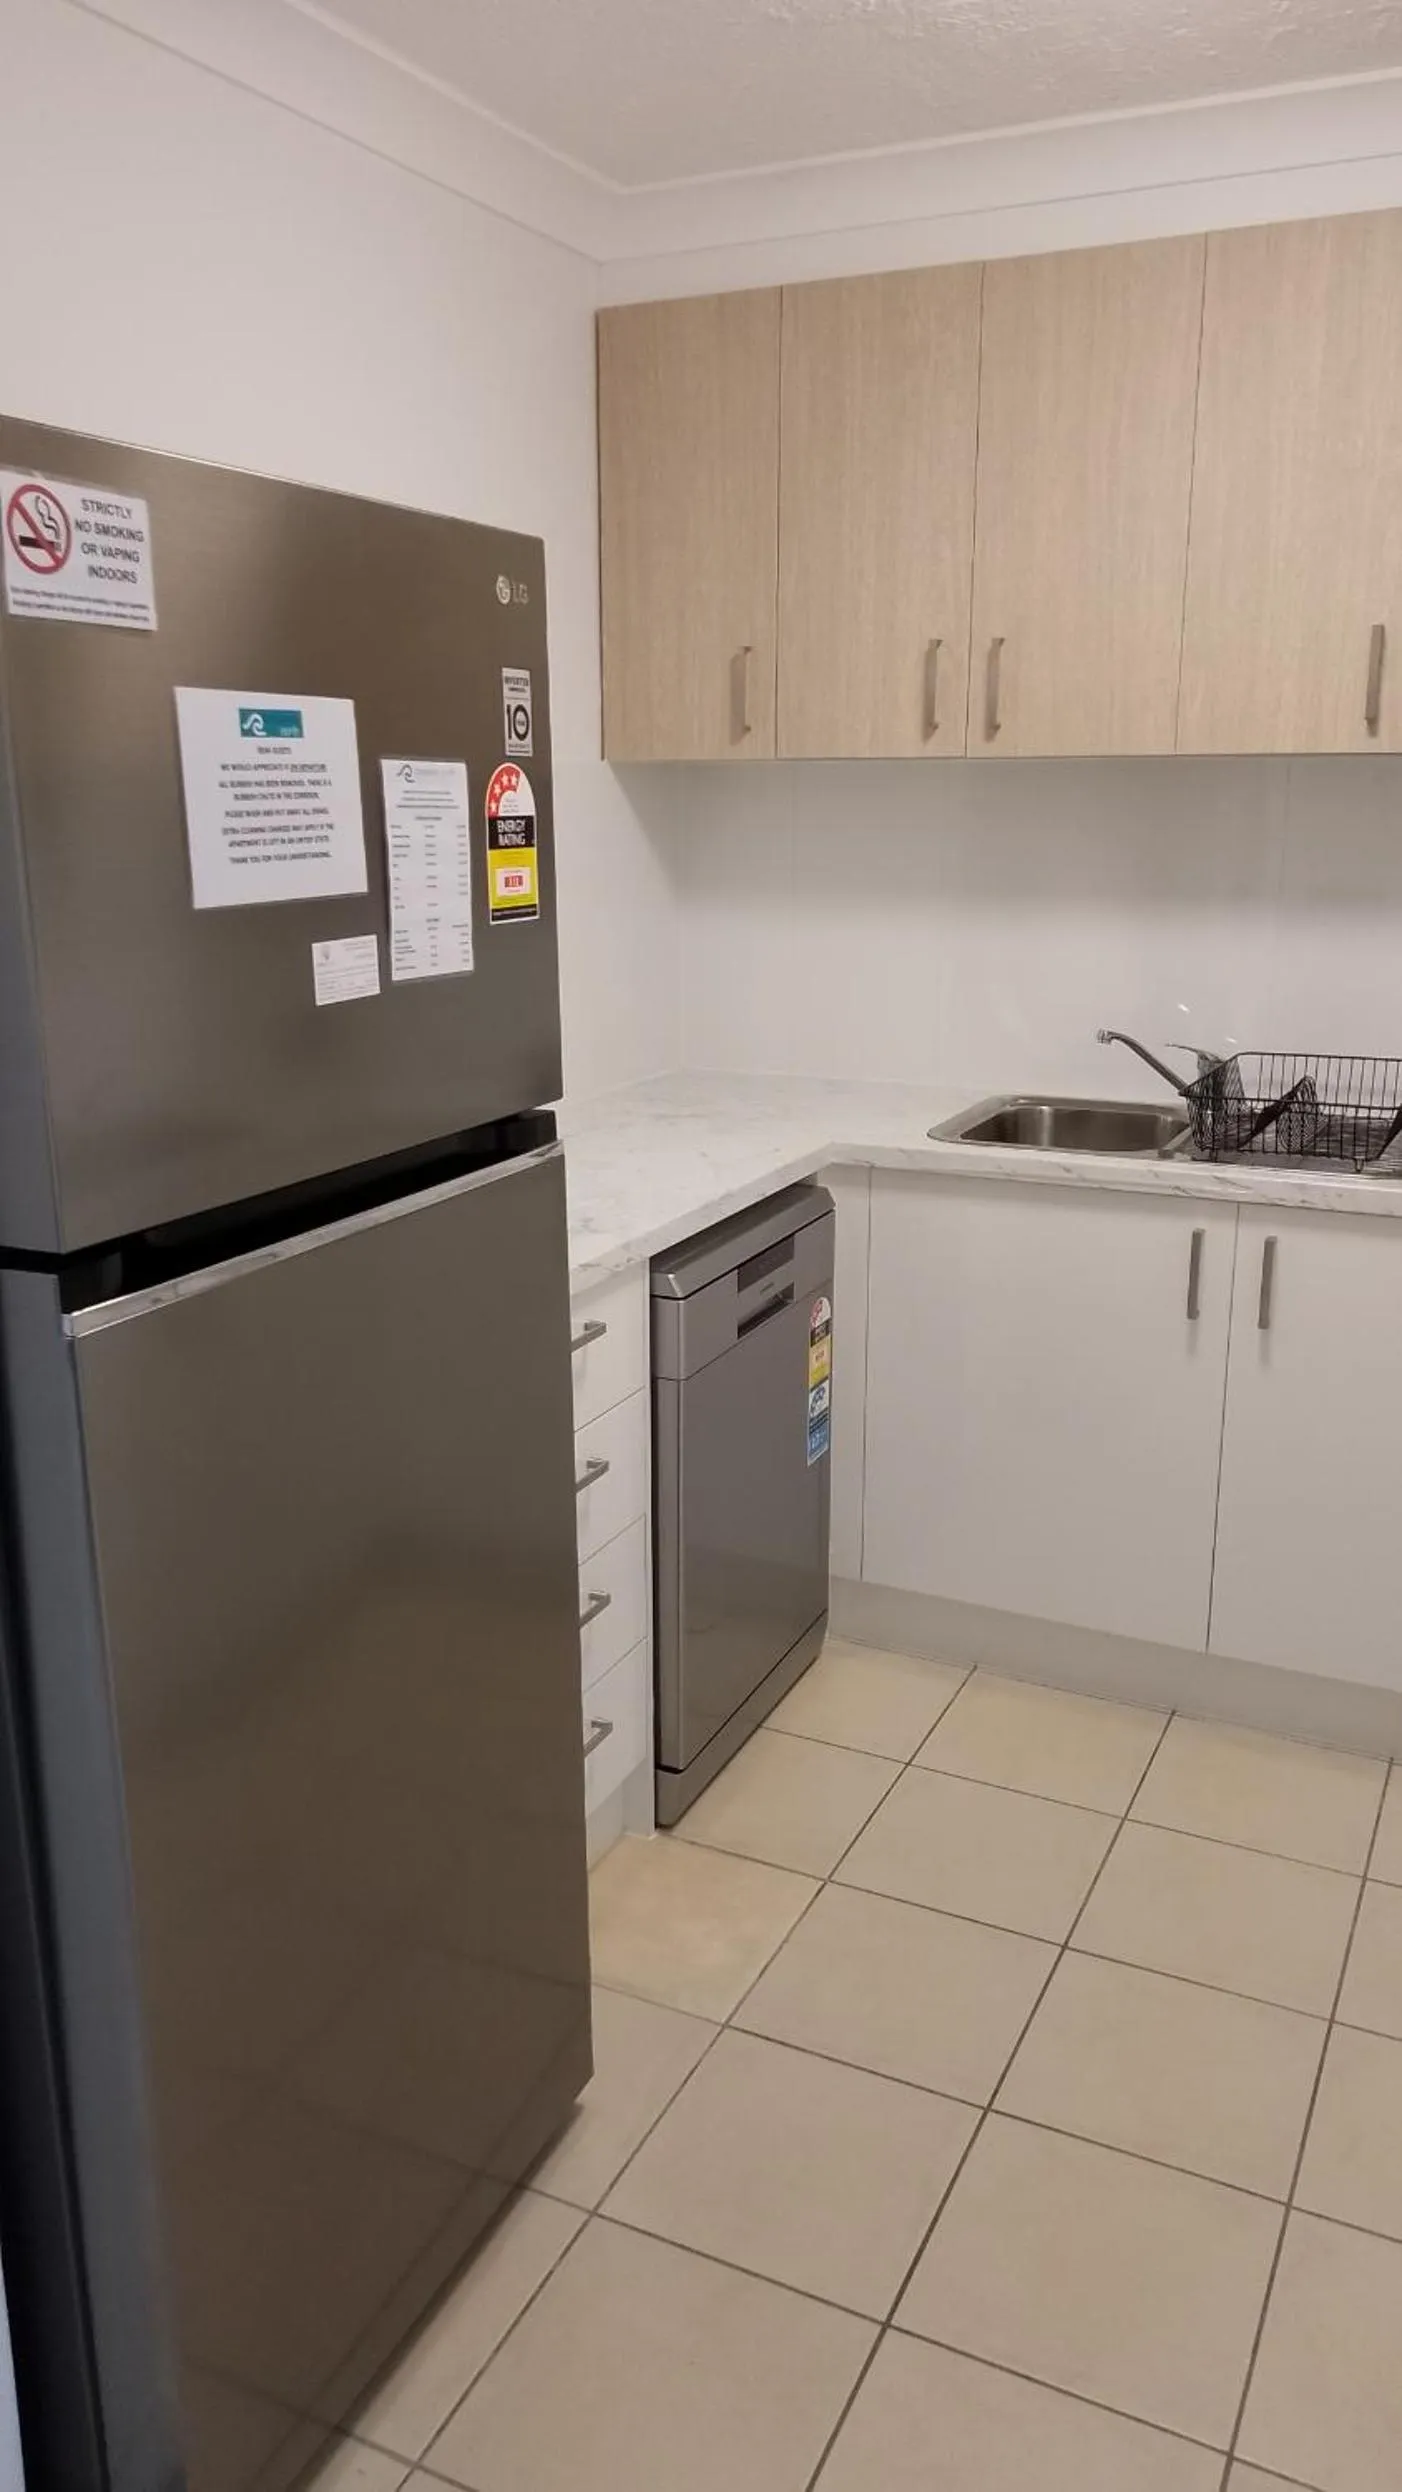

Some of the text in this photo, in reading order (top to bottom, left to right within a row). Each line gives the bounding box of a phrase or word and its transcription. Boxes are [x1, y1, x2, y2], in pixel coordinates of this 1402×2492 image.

[81, 497, 133, 520] STRICTLY
[74, 519, 145, 543] NO SMOKING
[80, 541, 140, 564] OR VAPING
[87, 564, 138, 585] INDOORS
[506, 703, 530, 742] 10
